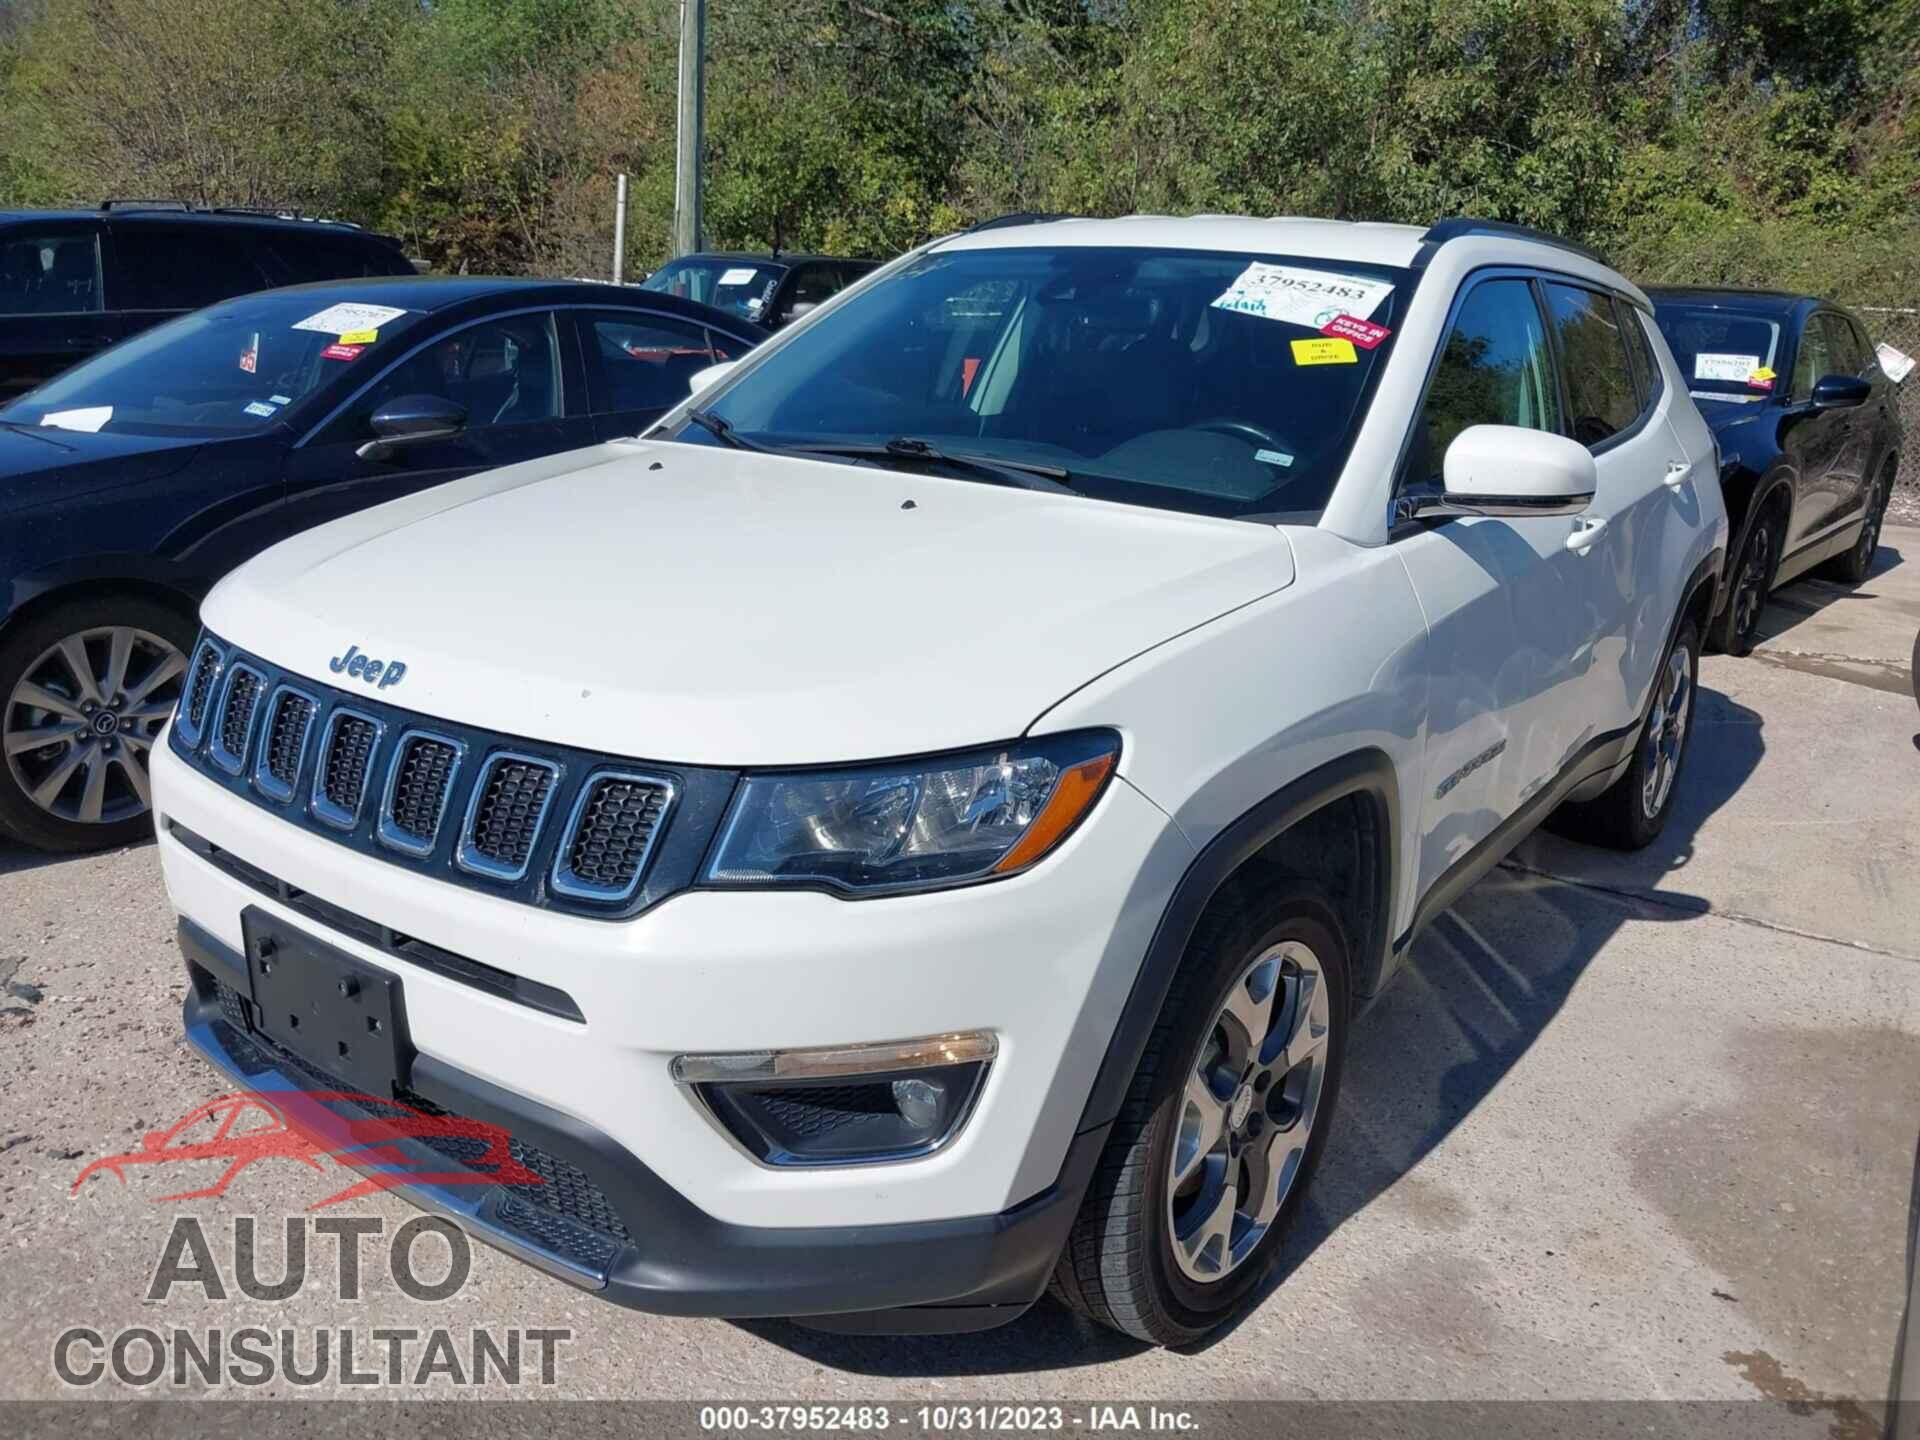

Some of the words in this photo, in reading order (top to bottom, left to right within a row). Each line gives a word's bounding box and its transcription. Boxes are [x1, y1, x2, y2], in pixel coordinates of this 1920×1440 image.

[1252, 274, 1366, 301] 37952483
[1331, 324, 1374, 343] OFFICE
[1335, 318, 1368, 332] KEYS
[1368, 328, 1385, 338] IN
[329, 645, 407, 690] Jeep
